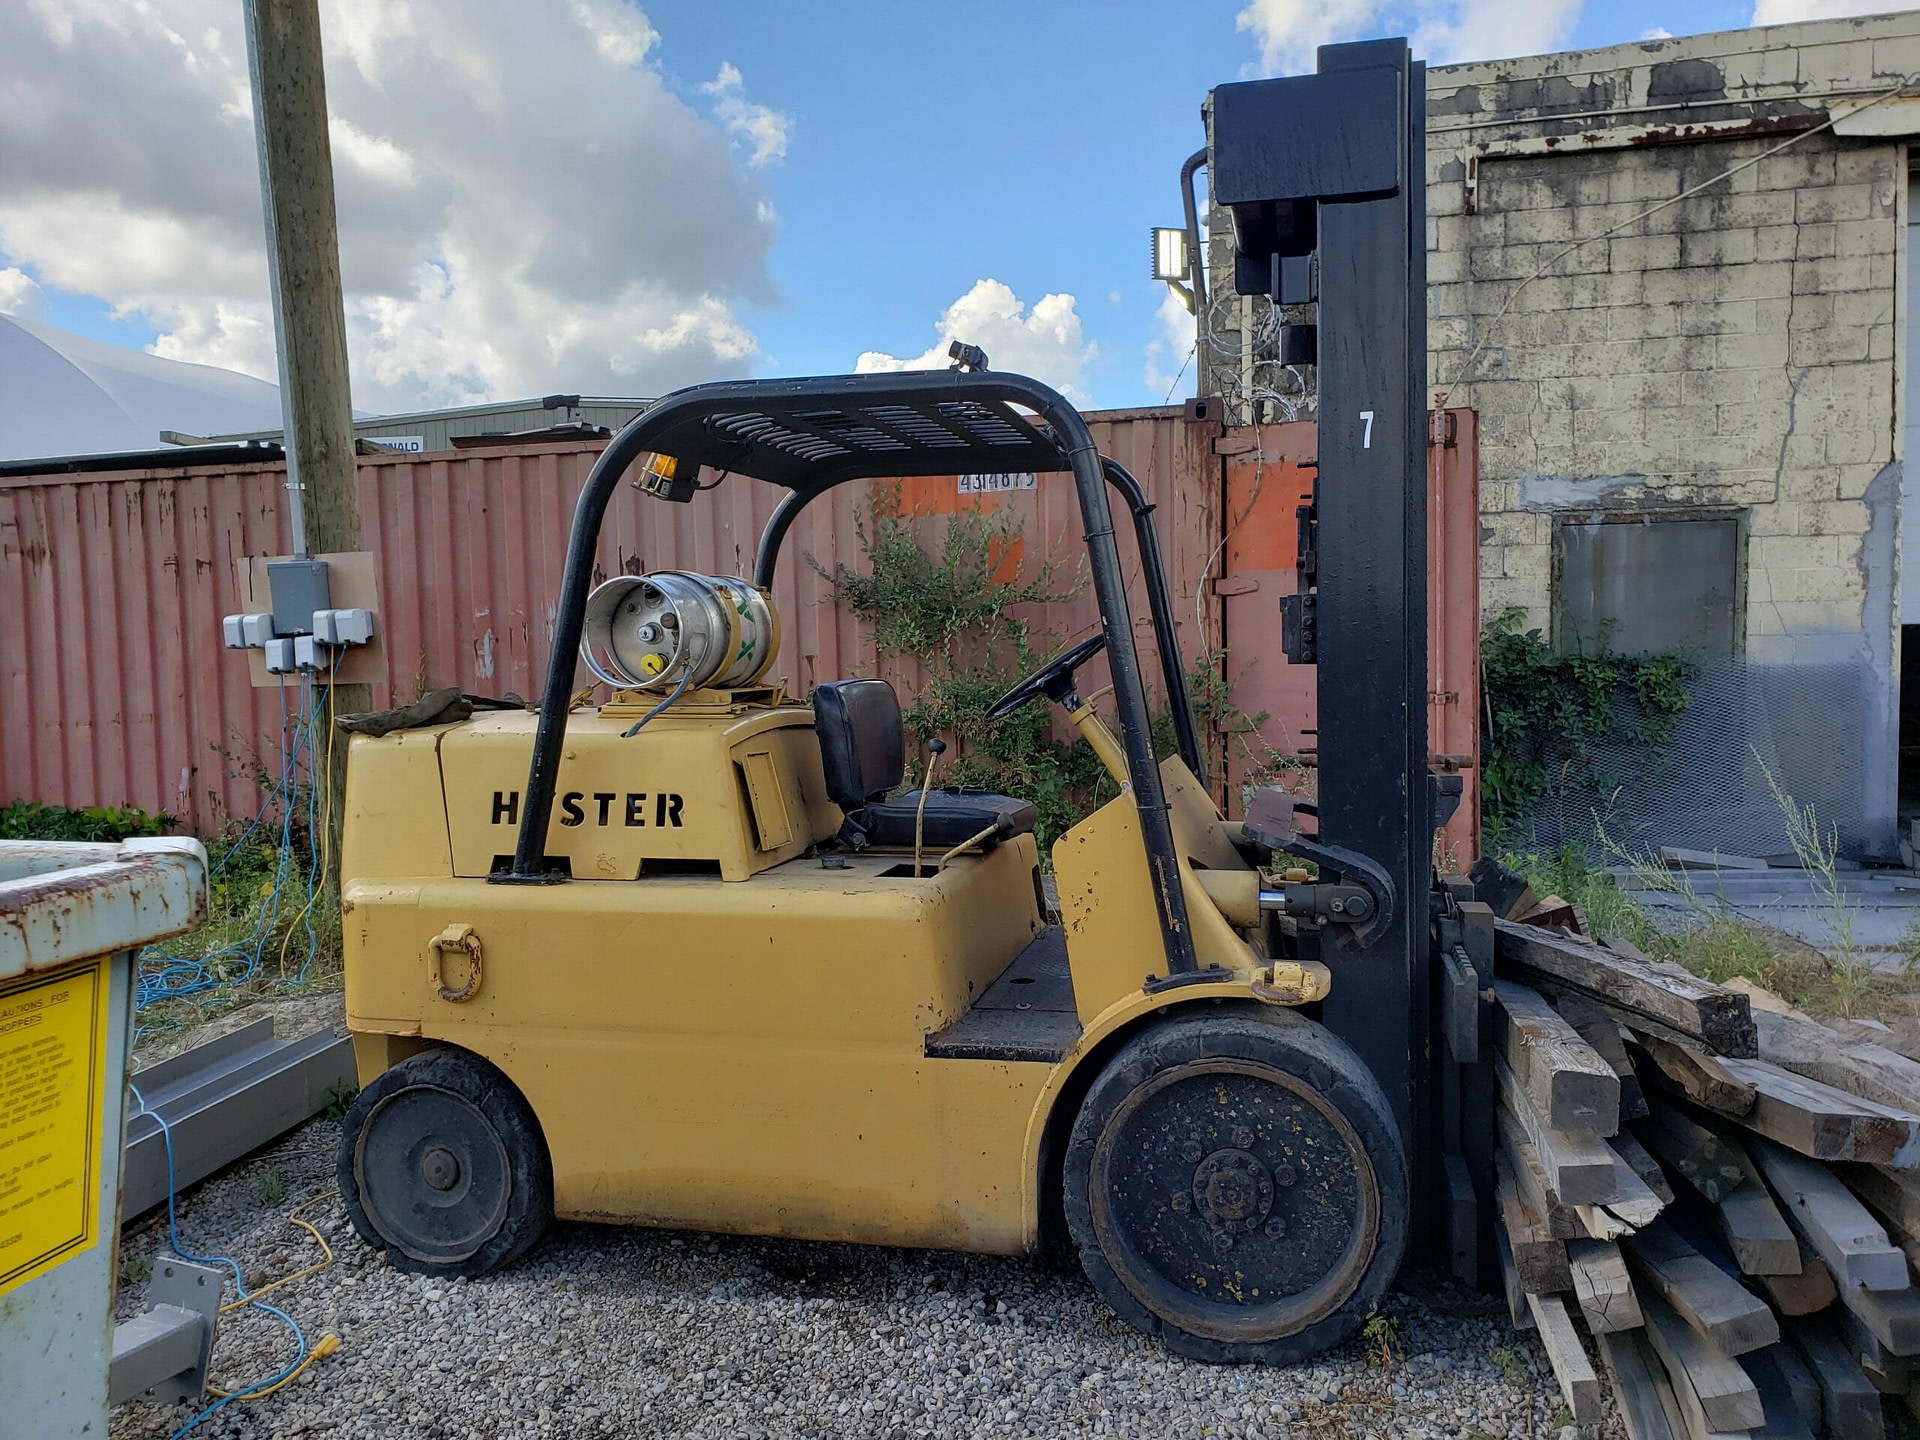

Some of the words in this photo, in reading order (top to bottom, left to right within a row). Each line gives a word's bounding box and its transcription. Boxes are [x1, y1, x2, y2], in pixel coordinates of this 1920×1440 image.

[1360, 411, 1374, 449] 7
[491, 791, 685, 827] HSTER
[0, 999, 42, 1018] AUTIONS
[50, 991, 69, 1003] FOR
